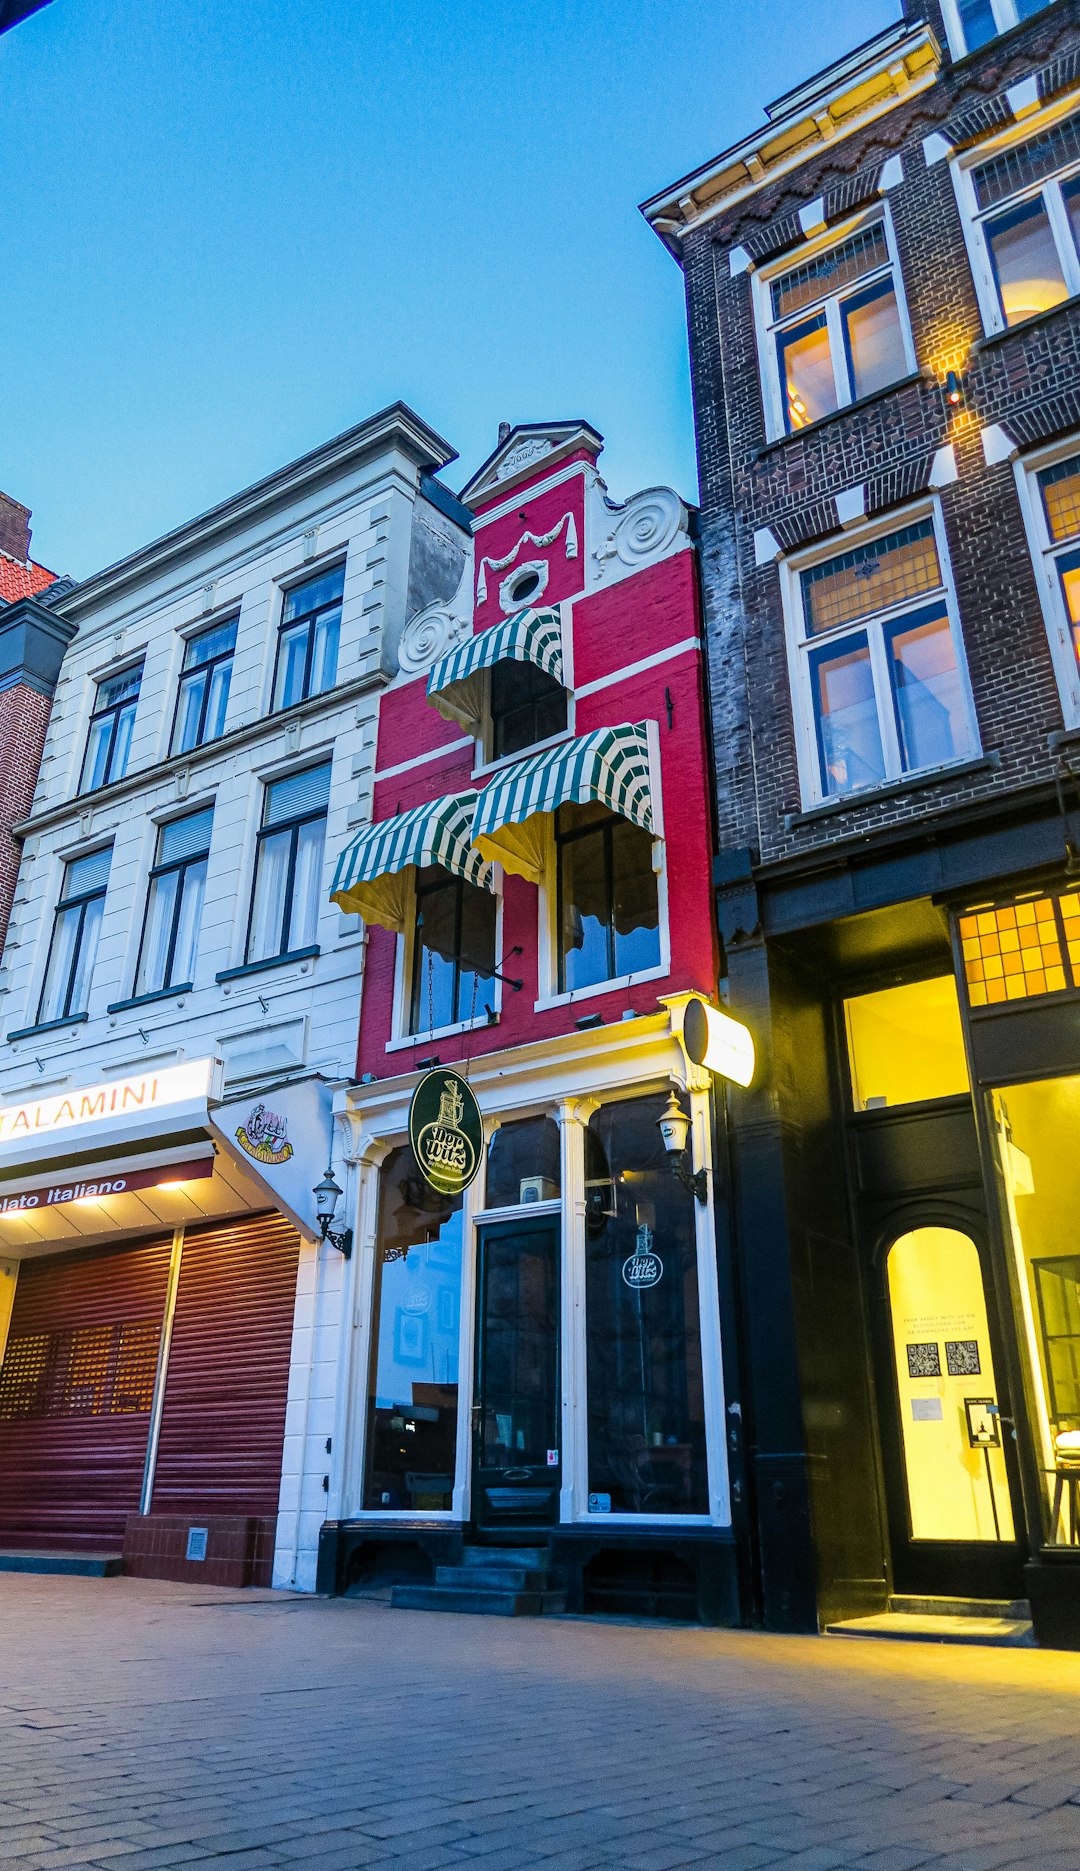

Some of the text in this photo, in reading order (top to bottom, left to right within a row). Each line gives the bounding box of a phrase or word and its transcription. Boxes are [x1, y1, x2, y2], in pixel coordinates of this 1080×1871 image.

[432, 1126, 464, 1149] Der
[426, 1139, 466, 1169] Witz
[47, 1180, 127, 1203] Italiano
